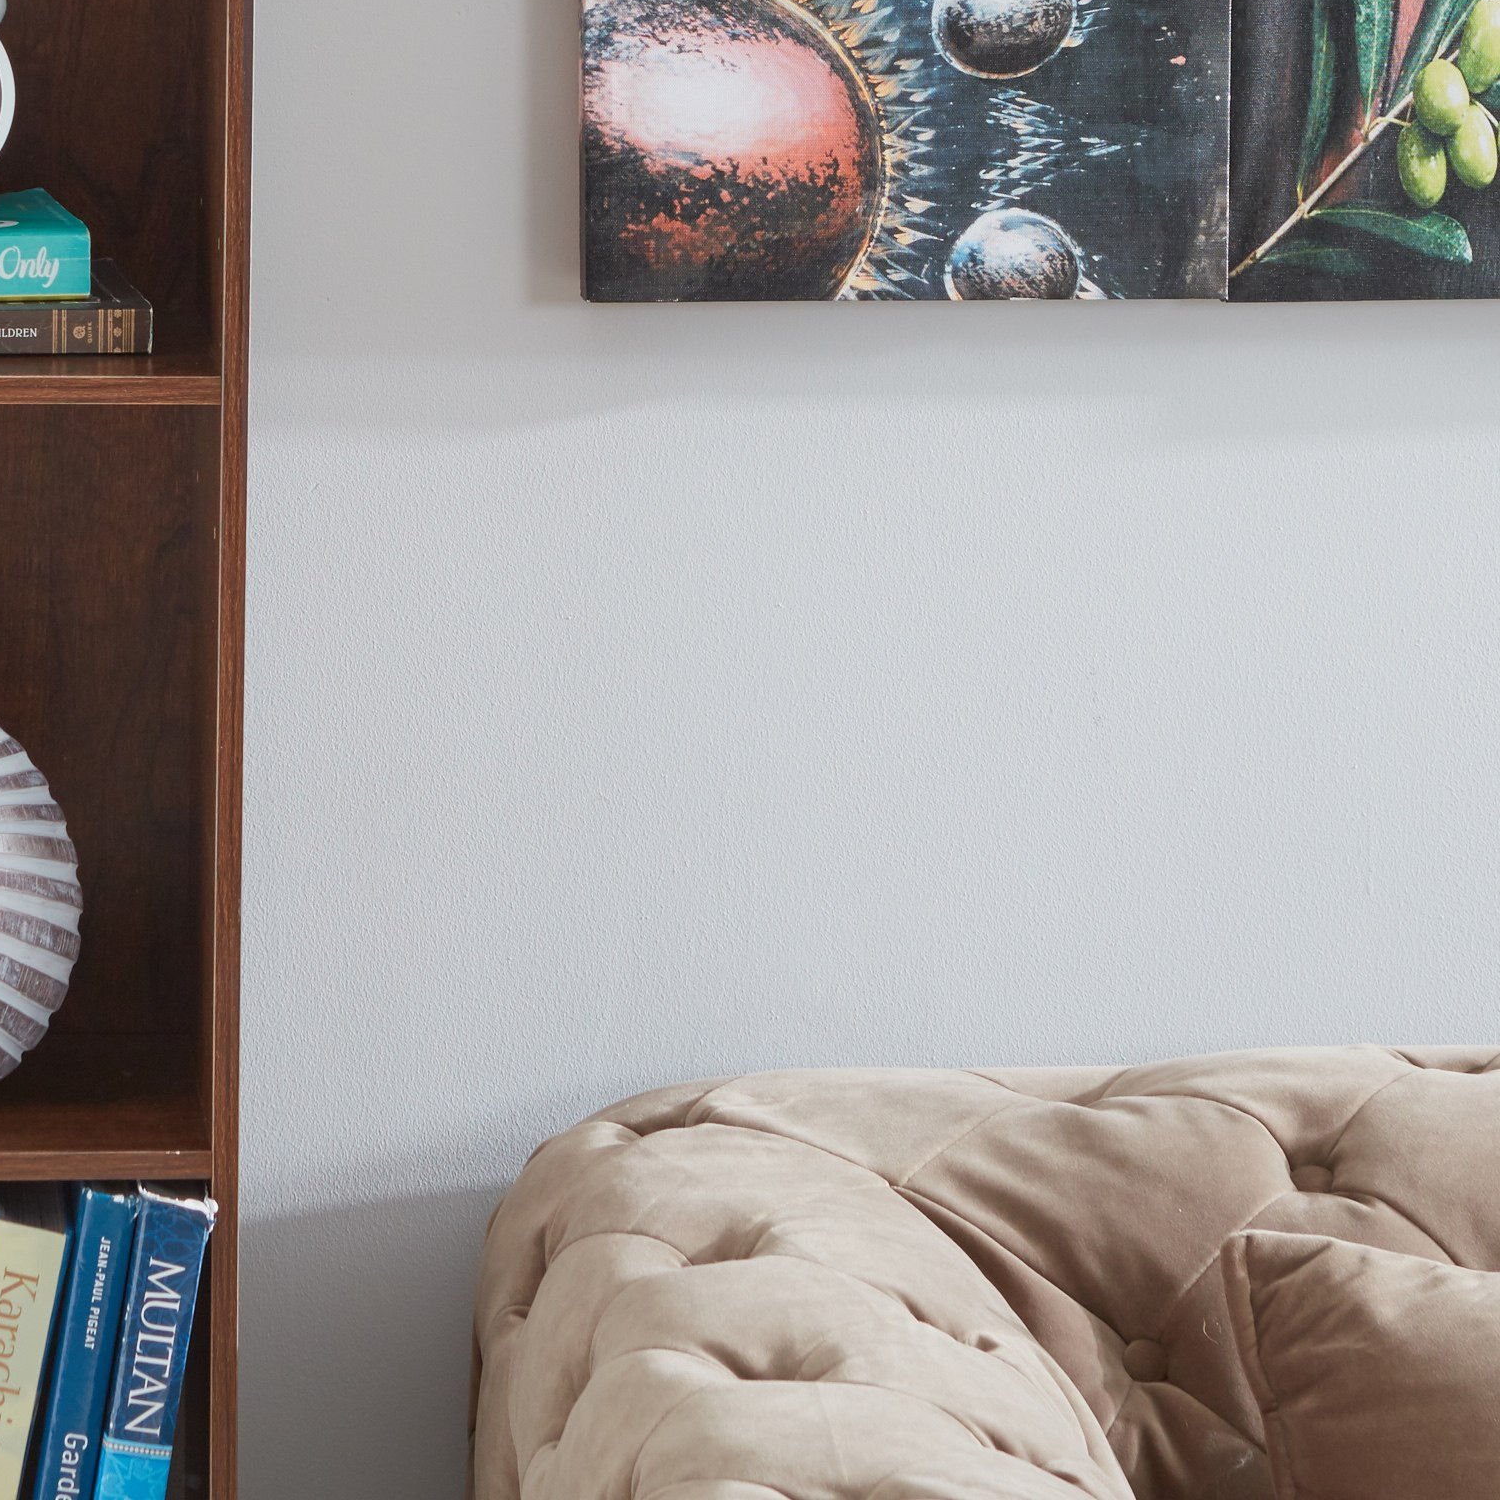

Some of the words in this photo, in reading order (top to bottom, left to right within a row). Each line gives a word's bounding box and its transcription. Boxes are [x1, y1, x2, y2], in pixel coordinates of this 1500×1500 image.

[91, 1236, 111, 1303] JEAN-PAUL
[84, 1306, 100, 1350] PIGEAT
[124, 1256, 186, 1437] MULTAN
